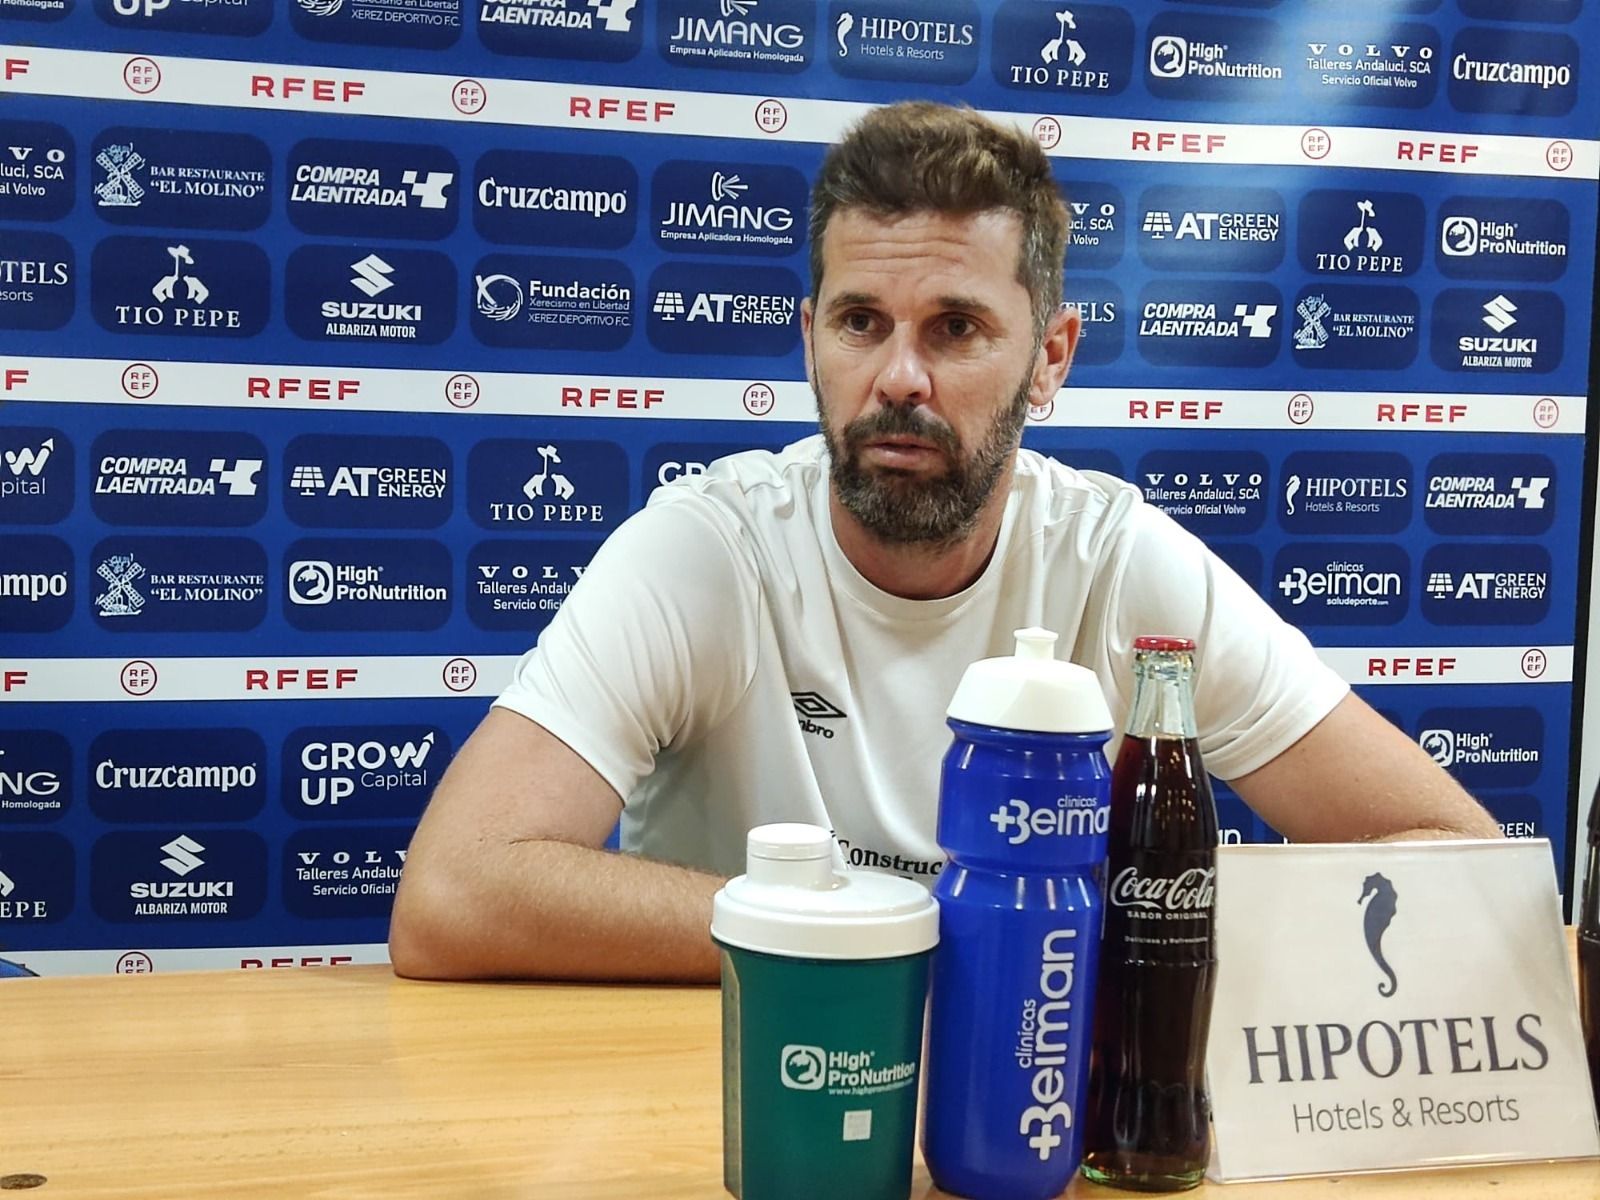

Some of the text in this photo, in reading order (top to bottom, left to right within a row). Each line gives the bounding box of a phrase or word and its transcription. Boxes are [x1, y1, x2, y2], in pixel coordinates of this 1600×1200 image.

[481, 5, 592, 29] LAENTRADA
[671, 18, 803, 48] JIMANG
[861, 18, 972, 45] HIPOTELS
[670, 45, 803, 62] Empresa Aplicadora Homologada
[861, 44, 944, 59] Hotels & Resorts
[1189, 43, 1223, 61] High
[1308, 44, 1432, 59] VOLVO
[1188, 61, 1282, 79] ProNutrition
[1307, 58, 1352, 70] Talleres
[1410, 61, 1430, 73] SCA
[1454, 53, 1570, 88] Cruzcampo
[1011, 66, 1108, 88] TIO PEPE
[1322, 74, 1417, 87] Servicio Oficial Volvo
[252, 76, 365, 102] RFEF
[570, 97, 675, 122] RFEF
[1132, 132, 1225, 153] RFEF
[1398, 142, 1478, 163] RFEF
[1, 163, 64, 179] luci, SCA
[151, 166, 264, 181] BAR RESTAURANTE
[297, 165, 379, 186] COMPRA
[13, 183, 45, 195] Volvo
[291, 184, 406, 206] LAENTRADA
[479, 177, 626, 217] Cruzcampo
[662, 203, 793, 230] JIMANG
[1090, 218, 1113, 230] SCA
[1219, 213, 1278, 228] GREEN
[1175, 213, 1218, 239] AT
[1219, 228, 1278, 241] ENERGY
[1481, 222, 1513, 239] High
[661, 230, 792, 245] Empresa Aplicadora Homologada
[1073, 234, 1098, 245] Volvo
[1480, 239, 1565, 255] ProNutrition
[1317, 254, 1402, 272] TIO PEPE
[0, 261, 67, 284] TELS
[530, 281, 630, 300] Fundación
[322, 302, 421, 320] SUZUKI
[530, 297, 577, 308] Xerecismo
[593, 300, 629, 310] Libertad
[687, 294, 733, 322] AT
[734, 295, 794, 311] GREEN
[1144, 303, 1215, 319] COMPRA
[116, 306, 240, 327] TIO PEPE
[528, 313, 558, 323] XEREZ
[559, 314, 614, 325] DEPORTIVO
[732, 310, 793, 324] ENERGY
[1352, 314, 1414, 323] RESTAURANTE
[326, 323, 415, 337] ALBARIZA MOTOR
[1140, 320, 1238, 336] LAENTRADA
[1459, 337, 1537, 352] SUZUKI
[1463, 356, 1532, 367] ALBARIZA MOTOR
[248, 378, 360, 400] RFEF
[562, 388, 664, 409] RFEF
[1130, 401, 1222, 419] RFEF
[1378, 404, 1467, 422] RFEF
[101, 457, 186, 475] COMPRA
[328, 467, 377, 496] AT
[378, 468, 445, 483] GREEN
[1146, 474, 1261, 485] VOLVO
[1430, 477, 1494, 491] COMPRA
[2, 477, 45, 497] pital
[95, 477, 214, 495] LAENTRADA
[378, 484, 445, 497] ENERGY
[1145, 488, 1186, 500] Talleres
[1239, 488, 1259, 499] SCA
[1307, 479, 1406, 497] HIPOTELS
[1306, 502, 1379, 512] Hotels & Resorts
[1426, 493, 1514, 508] LAENTRADA
[490, 504, 603, 521] TIO PEPE
[1195, 505, 1221, 514] Oficial
[1224, 505, 1246, 514] Volvo
[151, 575, 263, 584] BAR RESTAURANTE
[337, 566, 378, 585] High
[479, 566, 587, 578] VOLV
[1496, 573, 1546, 586] GREEN
[337, 585, 446, 600] ProNutrition
[477, 582, 527, 593] Talleres
[1456, 573, 1495, 598] AT
[1495, 587, 1545, 598] ENERGY
[494, 599, 536, 609] Servicio
[1369, 658, 1456, 676] RFEF
[247, 669, 358, 690] RFEF
[1457, 733, 1488, 750] High
[301, 741, 431, 771] GROW
[1456, 748, 1538, 763] ProNutrition
[96, 759, 256, 792] Cruzcampo
[361, 770, 426, 790] Capital
[302, 778, 354, 805] UP
[298, 850, 408, 864] VOLV
[296, 868, 348, 880] Talleres
[131, 882, 233, 898] SUZUKI
[313, 883, 394, 895] Servicio Oficial
[1110, 867, 1215, 910] Coca-Cola
[135, 902, 227, 914] ALBARIZA MOTOR
[1127, 911, 1162, 919] SABOR
[1242, 1014, 1548, 1084] HIPOTELS
[829, 1052, 870, 1071] High
[828, 1062, 915, 1086] ProNutrition
[1293, 1096, 1519, 1133] Hotels & Resorts
